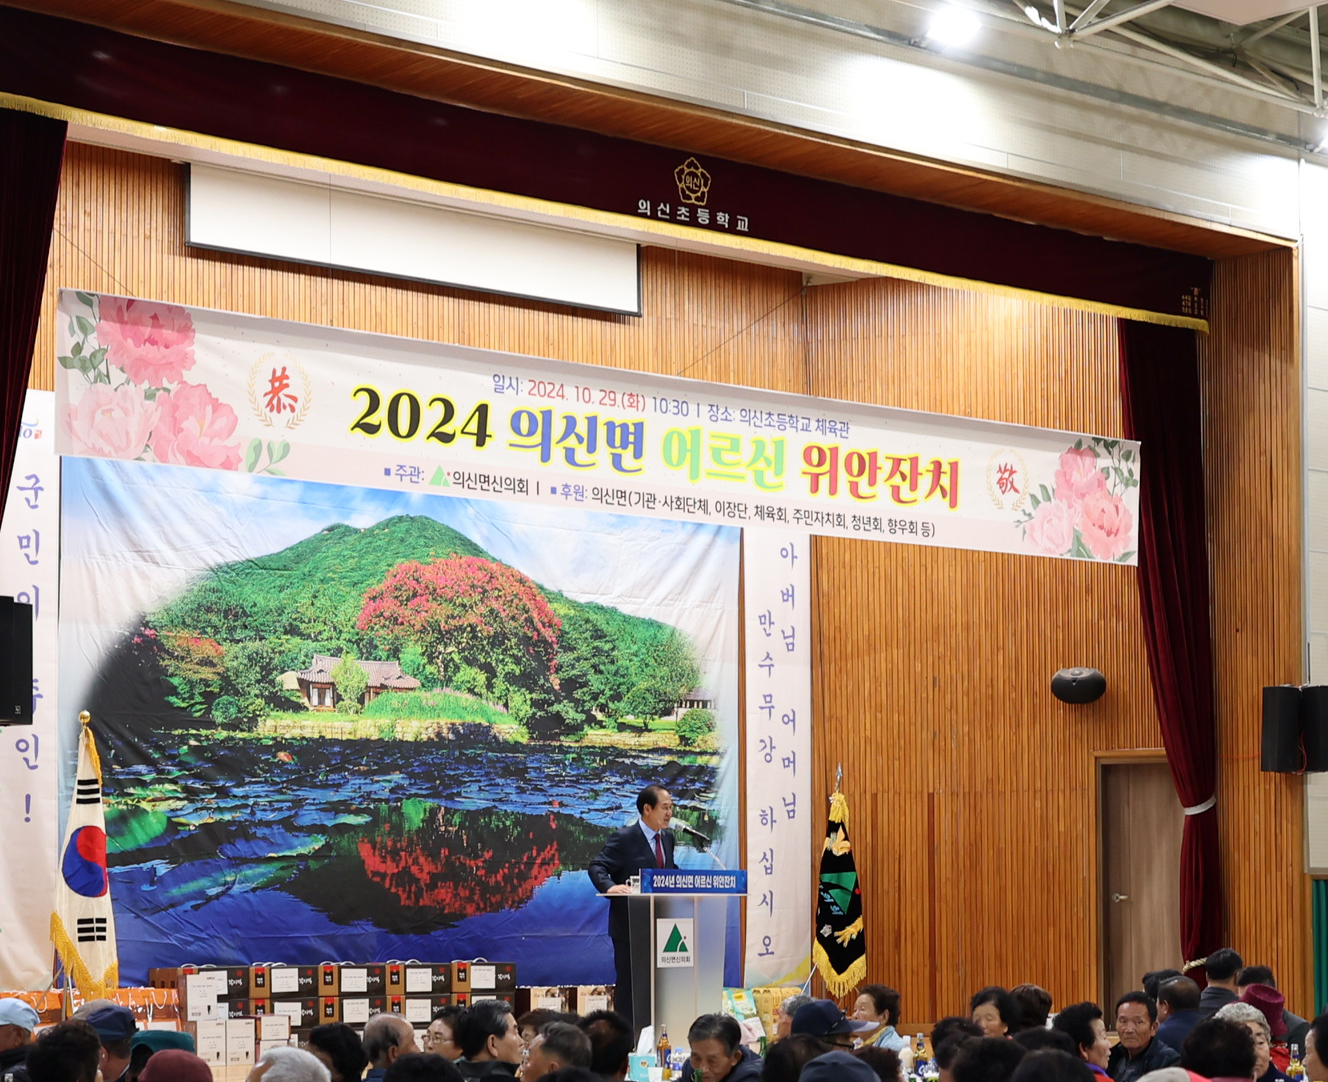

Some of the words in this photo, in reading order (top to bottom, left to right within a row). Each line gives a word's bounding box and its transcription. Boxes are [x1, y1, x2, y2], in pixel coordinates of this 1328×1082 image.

[637, 199, 749, 232] 의신초등학교
[685, 175, 700, 190] 의신
[263, 366, 298, 414] 恭
[492, 374, 523, 396] 일시:
[528, 379, 569, 401] 2024.
[574, 386, 596, 405] 10.
[599, 390, 646, 412] 29.(화)
[652, 396, 689, 417] 10:30
[707, 403, 736, 424] 장소:
[739, 408, 812, 433] 의신초등학교
[815, 417, 850, 439] 체육관
[350, 387, 493, 448] 2024
[509, 408, 645, 474] 의신면
[662, 428, 785, 490] 어르신
[802, 445, 959, 509] 위안잔치
[995, 462, 1021, 496] 敬
[394, 464, 425, 484] 주관:
[452, 470, 530, 496] 의신면신의회
[560, 483, 588, 502] 후원:
[714, 501, 751, 521] 이장단,
[754, 505, 790, 525] 체육회,
[792, 508, 848, 530] 주민자치회,
[851, 514, 885, 533] 청년회,
[887, 518, 918, 537] 향우회
[920, 522, 935, 538] 등)
[779, 541, 798, 653] 아버님
[757, 609, 776, 764] 만수무강
[780, 707, 797, 821] 어머님
[653, 875, 675, 888] 2024년
[676, 875, 694, 888] 의신면
[694, 875, 712, 888] 어르신
[713, 875, 736, 888] 위안잔치
[757, 805, 777, 957] 하십시오
